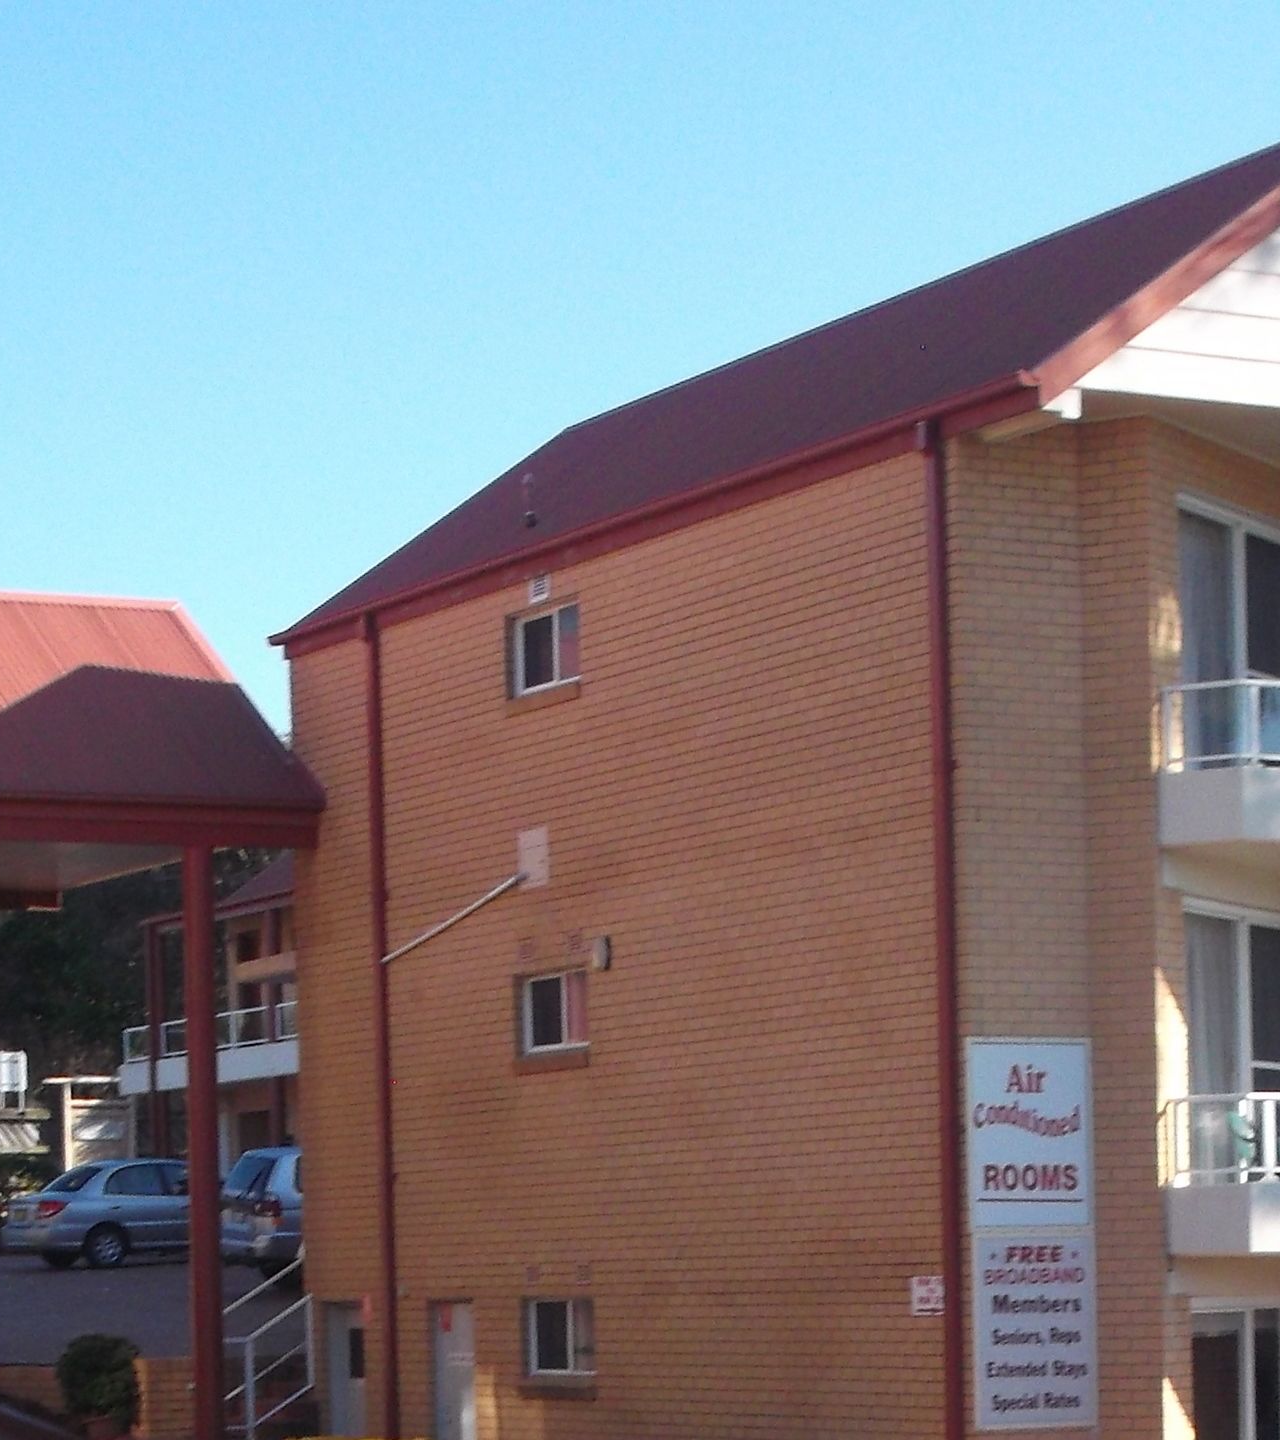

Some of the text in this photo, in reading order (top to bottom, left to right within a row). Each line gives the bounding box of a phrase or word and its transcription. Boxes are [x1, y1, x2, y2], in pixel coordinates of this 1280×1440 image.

[1005, 1064, 1048, 1093] Air
[973, 1102, 1081, 1137] Conditioned
[984, 1164, 1079, 1191] ROOMS
[1006, 1245, 1064, 1263] FREE
[984, 1268, 1085, 1285] BROADBAND
[992, 1294, 1082, 1313] Members
[992, 1327, 1082, 1346] Seniors, Reps
[986, 1360, 1088, 1379] Extended Stays
[992, 1392, 1081, 1412] Special Rates
